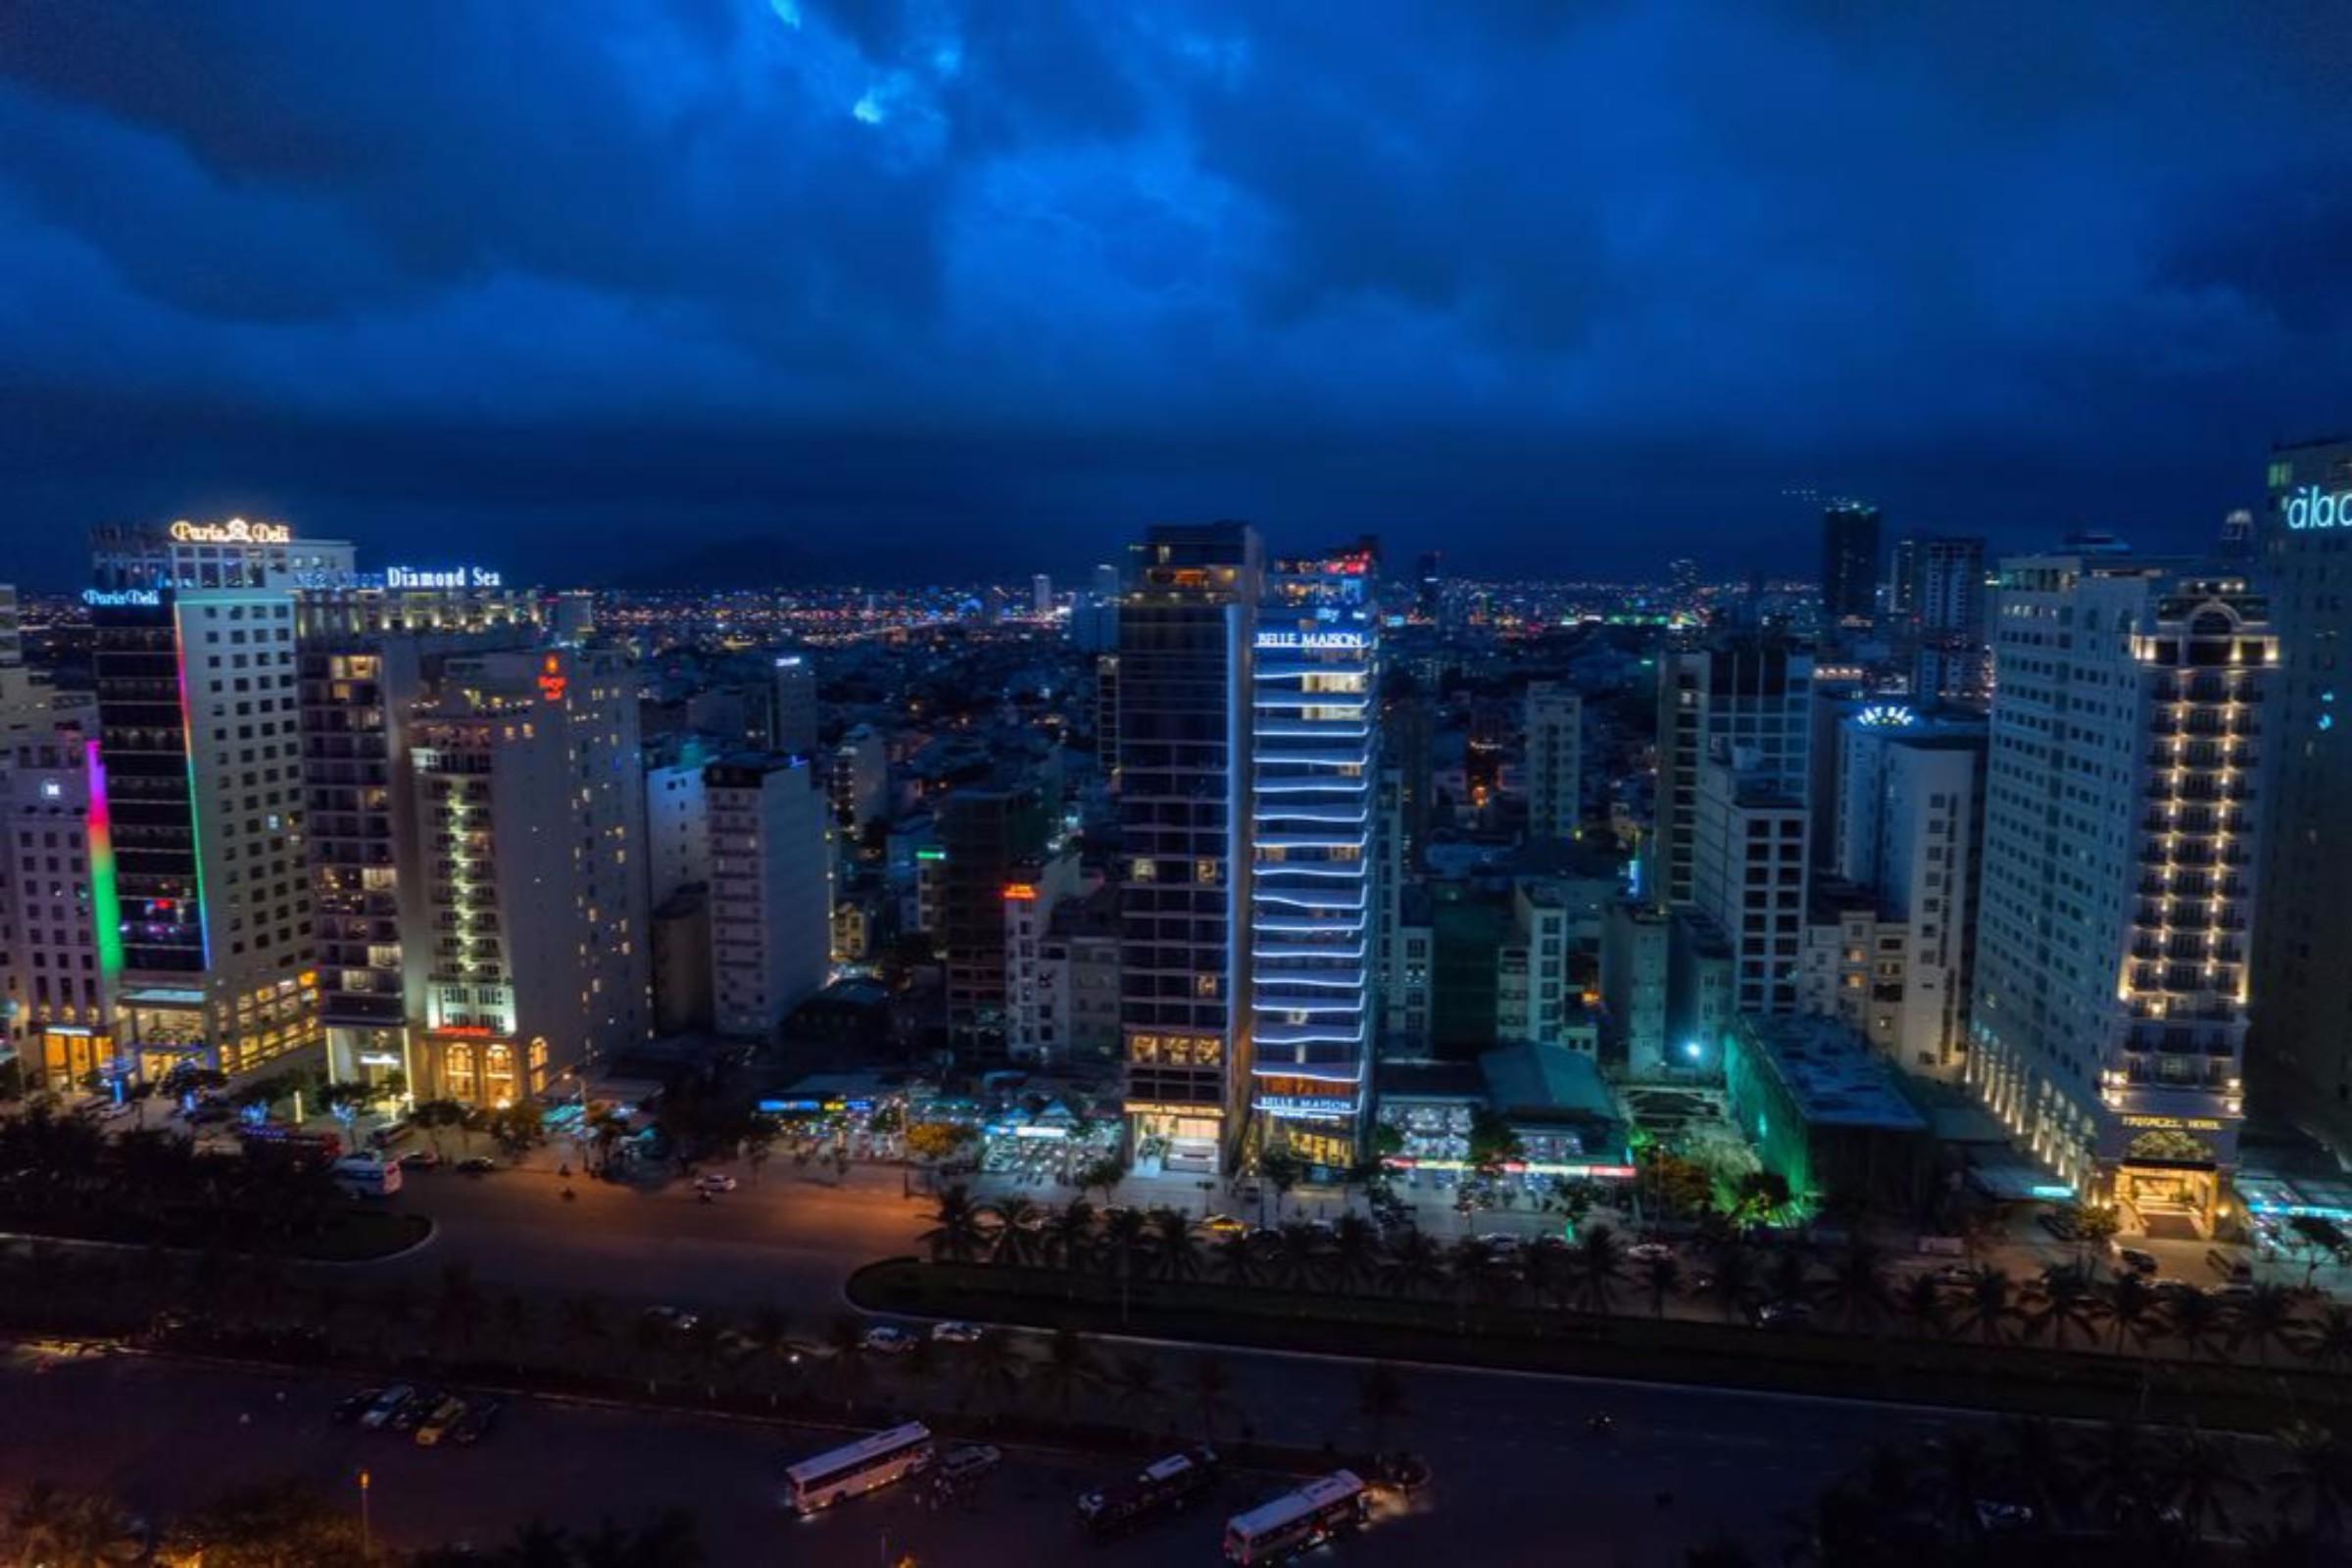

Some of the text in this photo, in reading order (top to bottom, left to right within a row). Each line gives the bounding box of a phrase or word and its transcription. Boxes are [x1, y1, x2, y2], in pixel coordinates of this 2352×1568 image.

[170, 520, 289, 542] Paris Deli
[387, 565, 466, 586] Diamond
[472, 565, 501, 586] Sea
[82, 590, 125, 605] Paris
[1257, 633, 1363, 646] BELLE MAISON
[1299, 1099, 1351, 1109] MAISON
